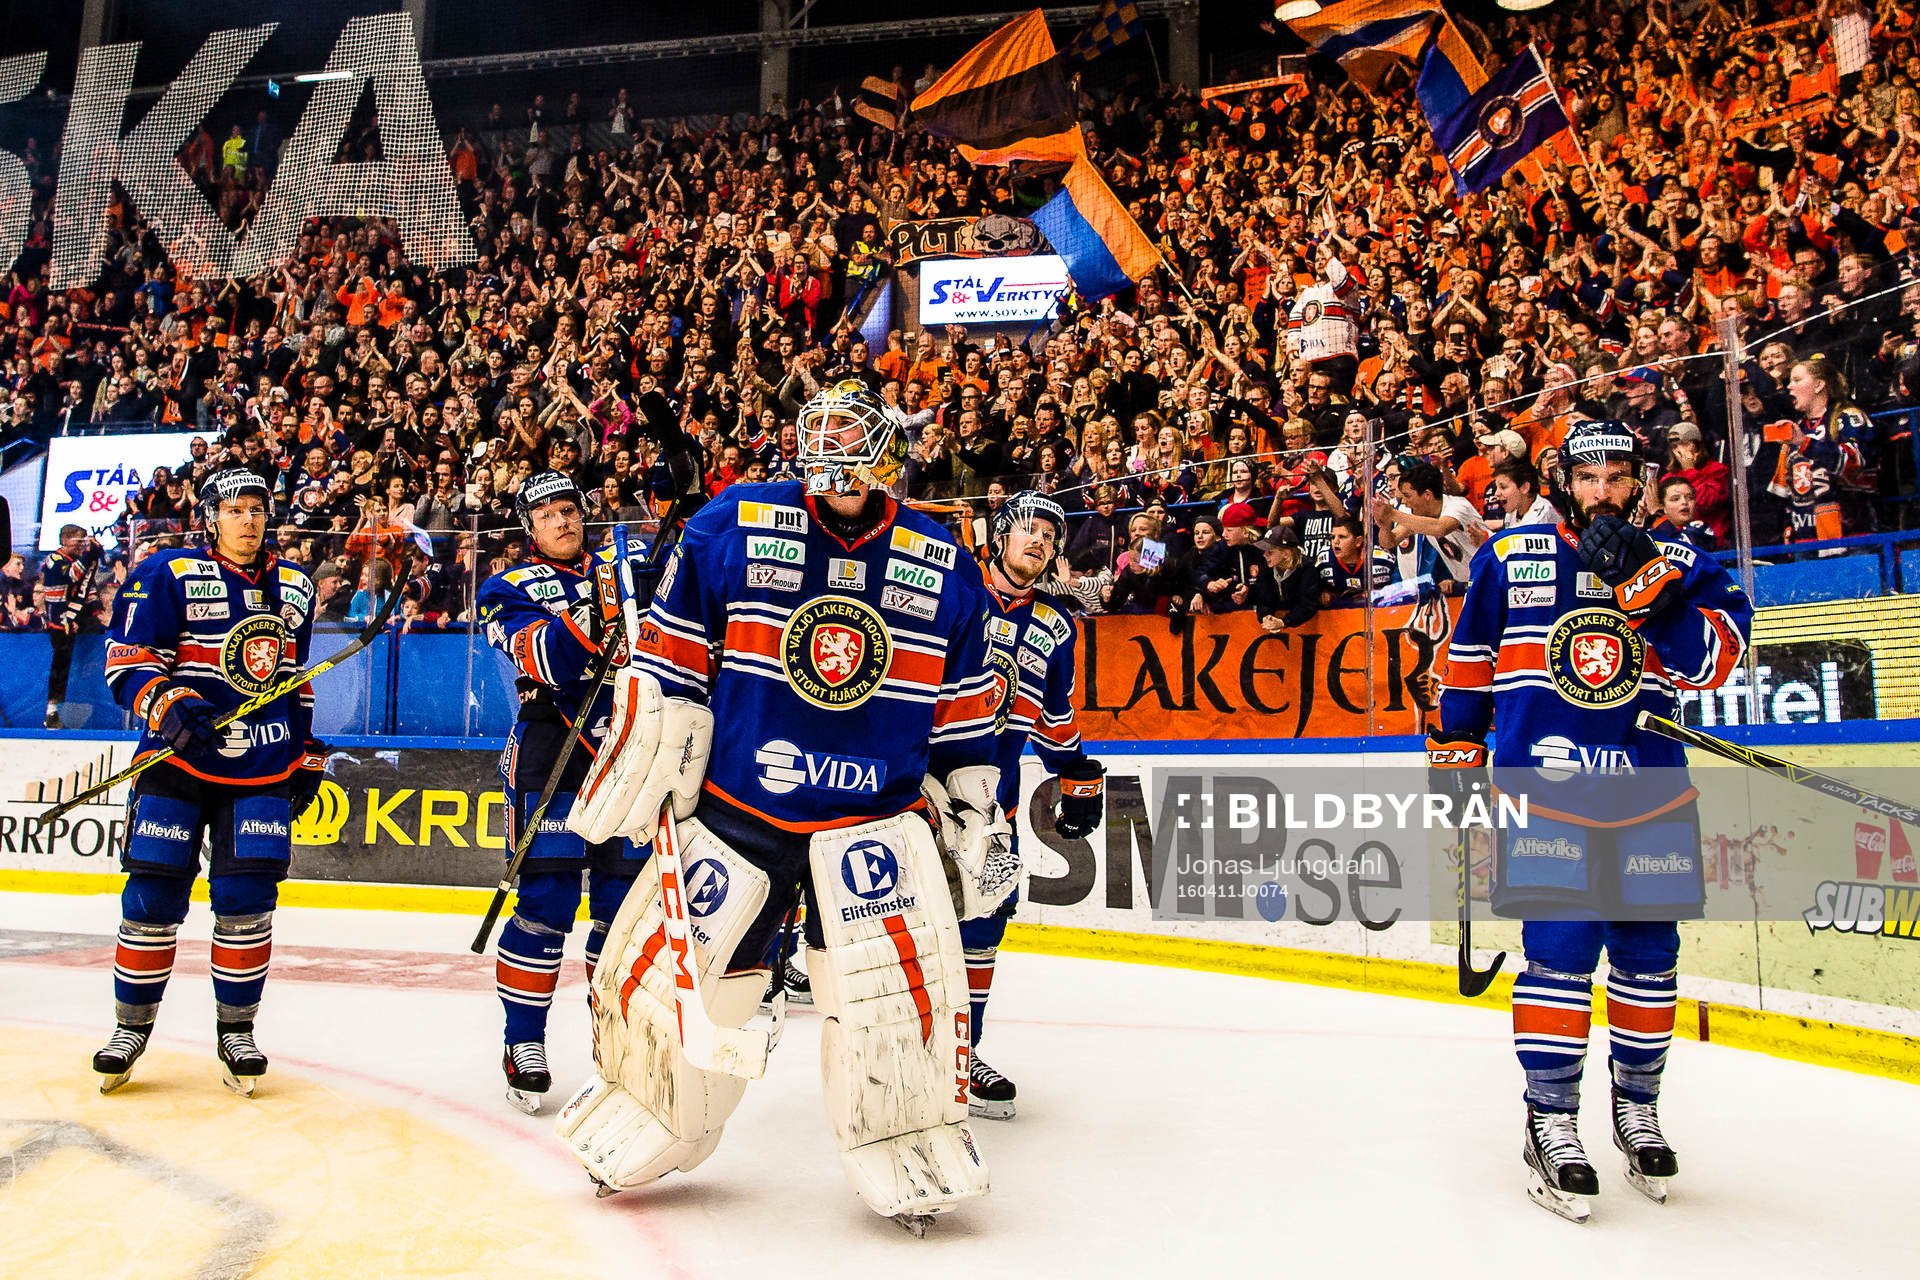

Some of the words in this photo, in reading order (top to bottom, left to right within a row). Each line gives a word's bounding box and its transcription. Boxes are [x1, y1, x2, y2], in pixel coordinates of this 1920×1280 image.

[1571, 438, 1631, 450] KARNHEM
[220, 477, 265, 489] KARNHEM
[527, 480, 573, 500] KARNHEM
[754, 540, 799, 561] wilo
[893, 567, 936, 589] wilo
[1513, 562, 1551, 579] wilo
[190, 582, 221, 597] wilo
[771, 578, 799, 590] PRODUKT
[830, 580, 864, 590] BALCO
[1578, 590, 1611, 598] BALCO
[906, 604, 934, 617] PRODUKT
[243, 619, 276, 635] LAKERS
[789, 612, 814, 649] VÄXJÖ
[814, 604, 861, 620] LAKERS
[860, 617, 884, 665] HOCKEY
[1552, 626, 1571, 660] VÄXJÖ
[1569, 615, 1616, 630] LAKERS
[1616, 624, 1642, 665] HOCKEY
[232, 673, 257, 692] STORT
[793, 668, 827, 699] STORT
[829, 680, 871, 701] HJÄRTA
[1558, 675, 1591, 701] STORT
[1594, 679, 1635, 702] HJÄRTA
[250, 720, 290, 748] VIDA
[803, 752, 878, 793] VIDA
[1820, 782, 1857, 800] ULTRA
[1856, 792, 1918, 821] TACKS
[138, 820, 190, 841] Atteviks
[241, 818, 288, 837] Atteviks
[1513, 838, 1583, 860] Atteviks
[1625, 854, 1693, 875] Atteviks
[655, 808, 694, 990] CCM
[841, 896, 916, 922] Elitfönster
[954, 1011, 970, 1105] CCM
